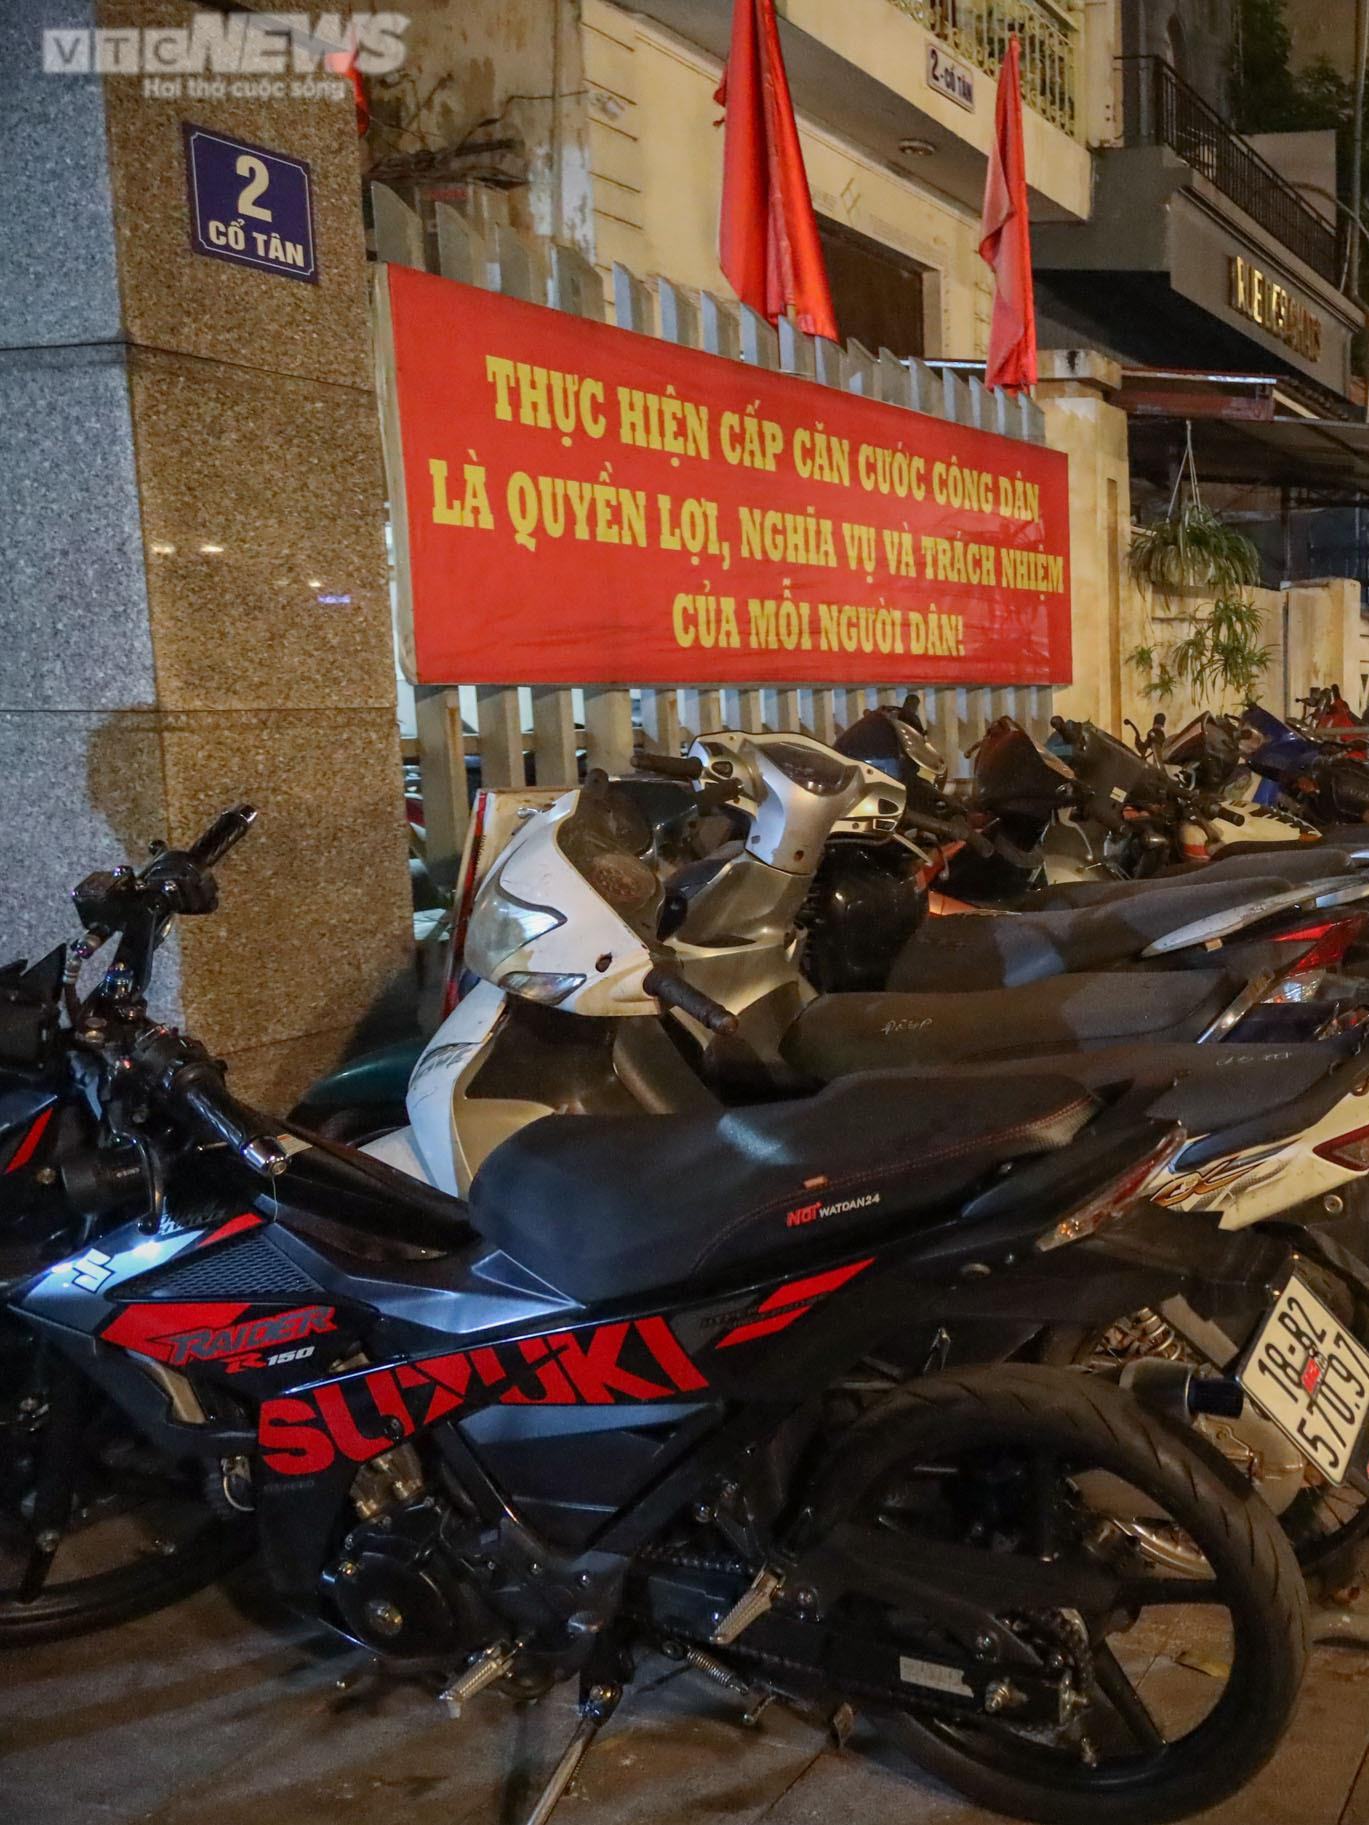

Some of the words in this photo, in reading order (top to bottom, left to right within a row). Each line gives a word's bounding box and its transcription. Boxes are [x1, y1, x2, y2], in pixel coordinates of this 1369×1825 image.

[236, 155, 272, 222] 2
[208, 218, 246, 250] CỔ
[252, 232, 305, 267] TÂN
[485, 355, 606, 447] THỰC
[617, 385, 710, 467] HIỆN
[720, 400, 784, 472] CẤP
[793, 421, 850, 487] CĂN
[858, 441, 925, 500] CƯỚC
[932, 455, 994, 514] CÔNG
[999, 471, 1040, 523] DÂN
[428, 449, 495, 530] LÀ
[507, 461, 648, 552] QUYỀN
[658, 494, 731, 570] LỢI,
[739, 506, 838, 567] NGHĨA
[842, 522, 877, 584] VỤ
[882, 521, 916, 577] VÀ
[921, 530, 996, 586] TRÁCH
[1001, 544, 1064, 600] NHIỆM
[673, 580, 741, 648] CỦA
[748, 577, 812, 650] MỖI
[819, 597, 904, 655] NGƯỜI
[908, 603, 965, 656] DÂN!
[165, 1305, 338, 1366] RAIDER
[258, 1315, 709, 1476] SUZUKI
